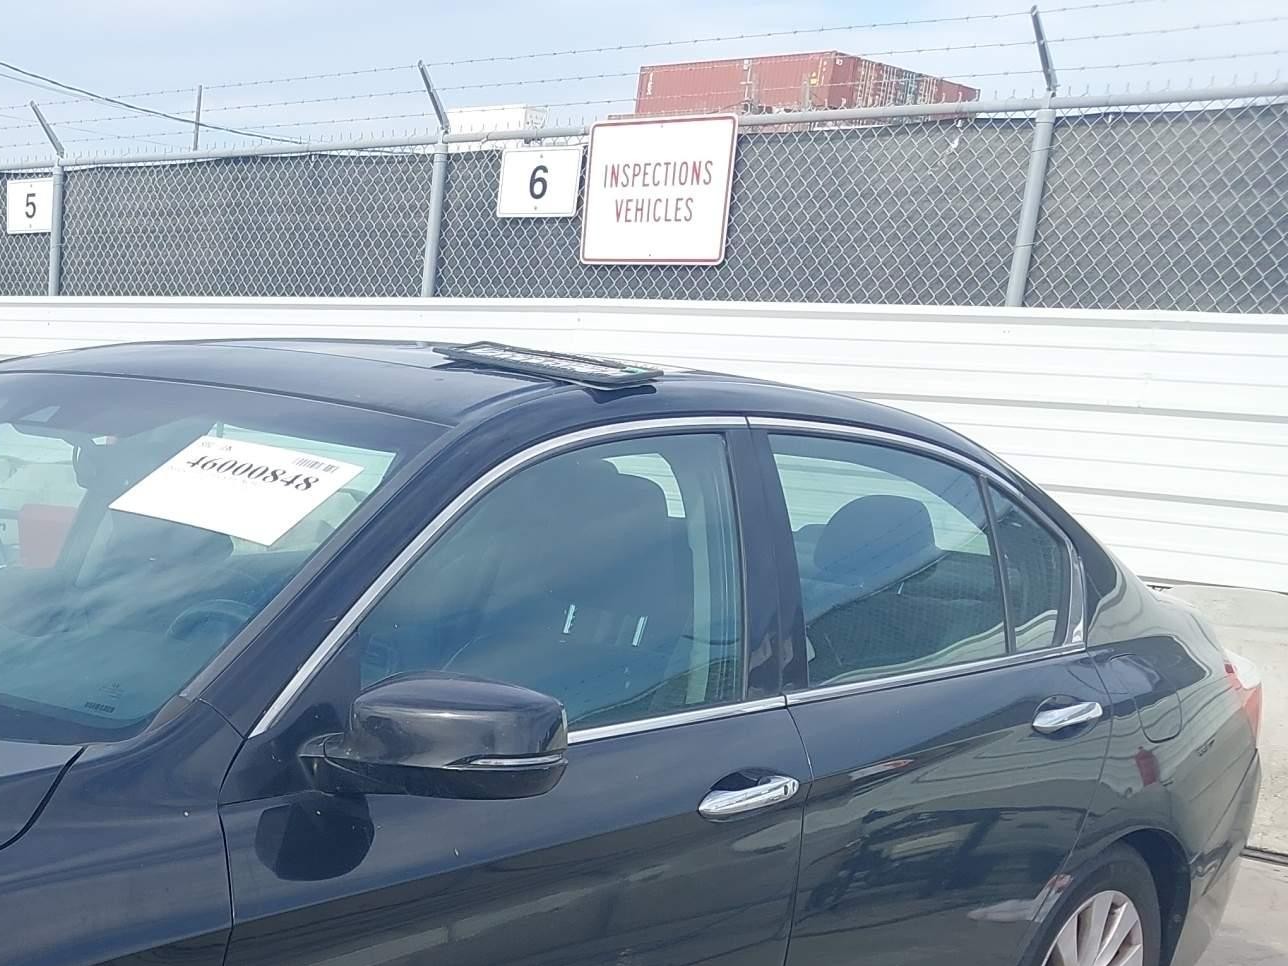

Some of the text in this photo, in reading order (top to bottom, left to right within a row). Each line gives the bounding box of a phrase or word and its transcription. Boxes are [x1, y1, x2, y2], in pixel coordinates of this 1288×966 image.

[528, 164, 549, 200] 6
[603, 160, 713, 188] INSPECTIONS
[24, 192, 37, 219] 5
[615, 197, 694, 223] VEHICLES
[185, 455, 320, 492] 46000848
